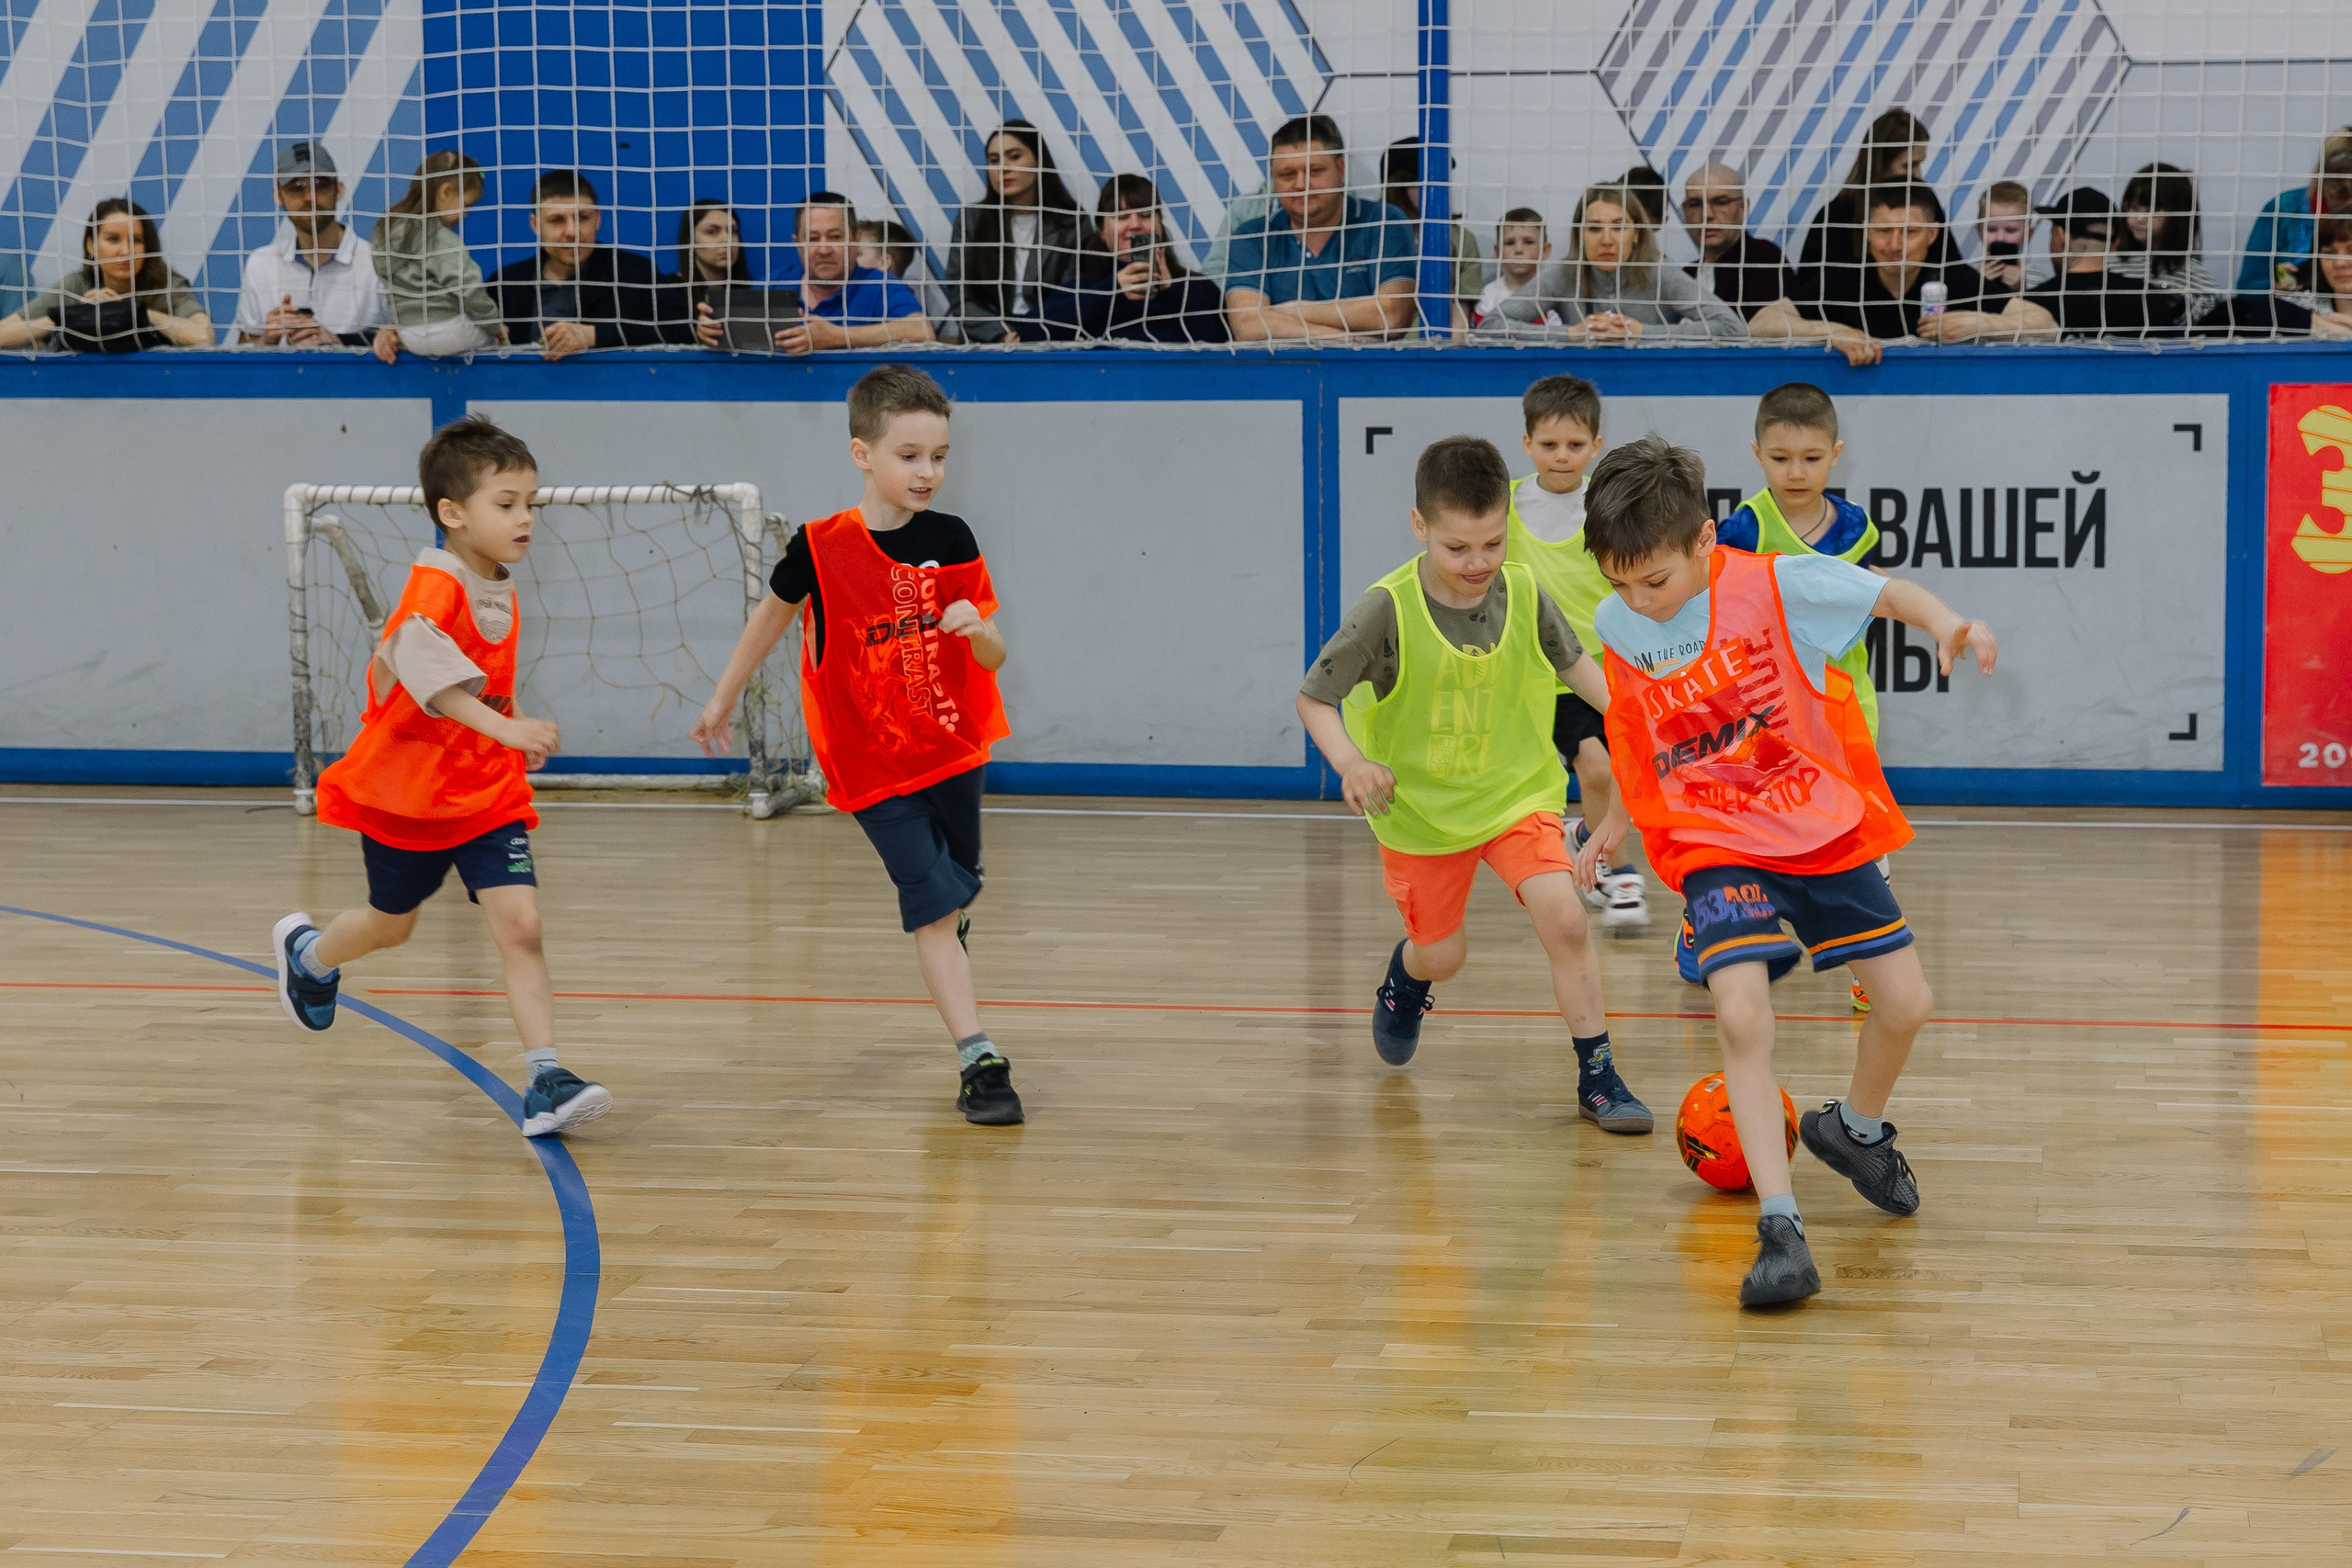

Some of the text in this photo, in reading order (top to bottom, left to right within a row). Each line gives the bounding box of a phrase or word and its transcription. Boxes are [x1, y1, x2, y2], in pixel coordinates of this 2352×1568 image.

[1869, 470, 2107, 569] ВАШЕЙ
[891, 563, 933, 716] CONTRAST
[1634, 639, 1706, 673] ON THE ROAD
[1649, 645, 1745, 720] SKATE
[1652, 705, 1777, 780] DEMIX
[2298, 741, 2352, 769] 20
